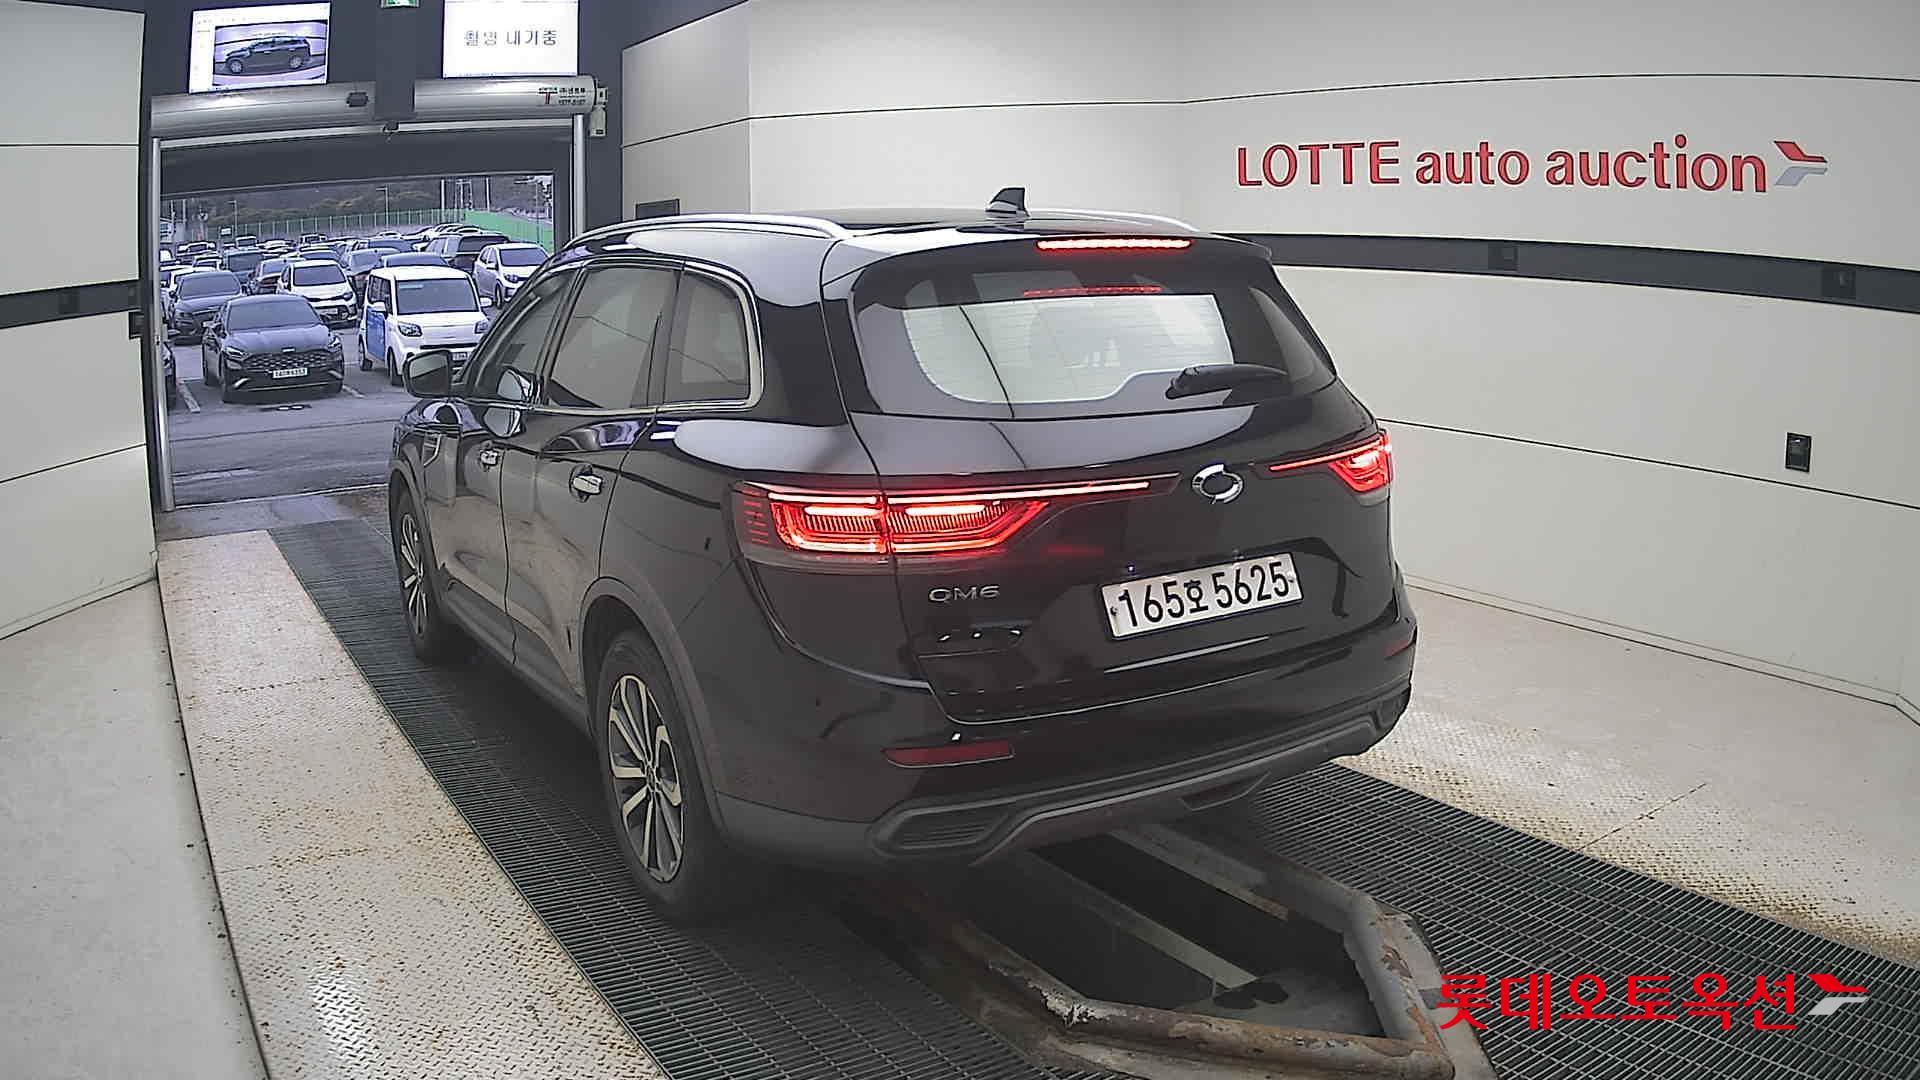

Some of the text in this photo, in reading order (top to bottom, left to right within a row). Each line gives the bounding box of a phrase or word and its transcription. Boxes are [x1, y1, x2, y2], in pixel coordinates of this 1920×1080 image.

[1238, 134, 1767, 194] LOTTE auto auction
[928, 585, 1000, 603] QM6
[1118, 561, 1289, 627] 165호 5625
